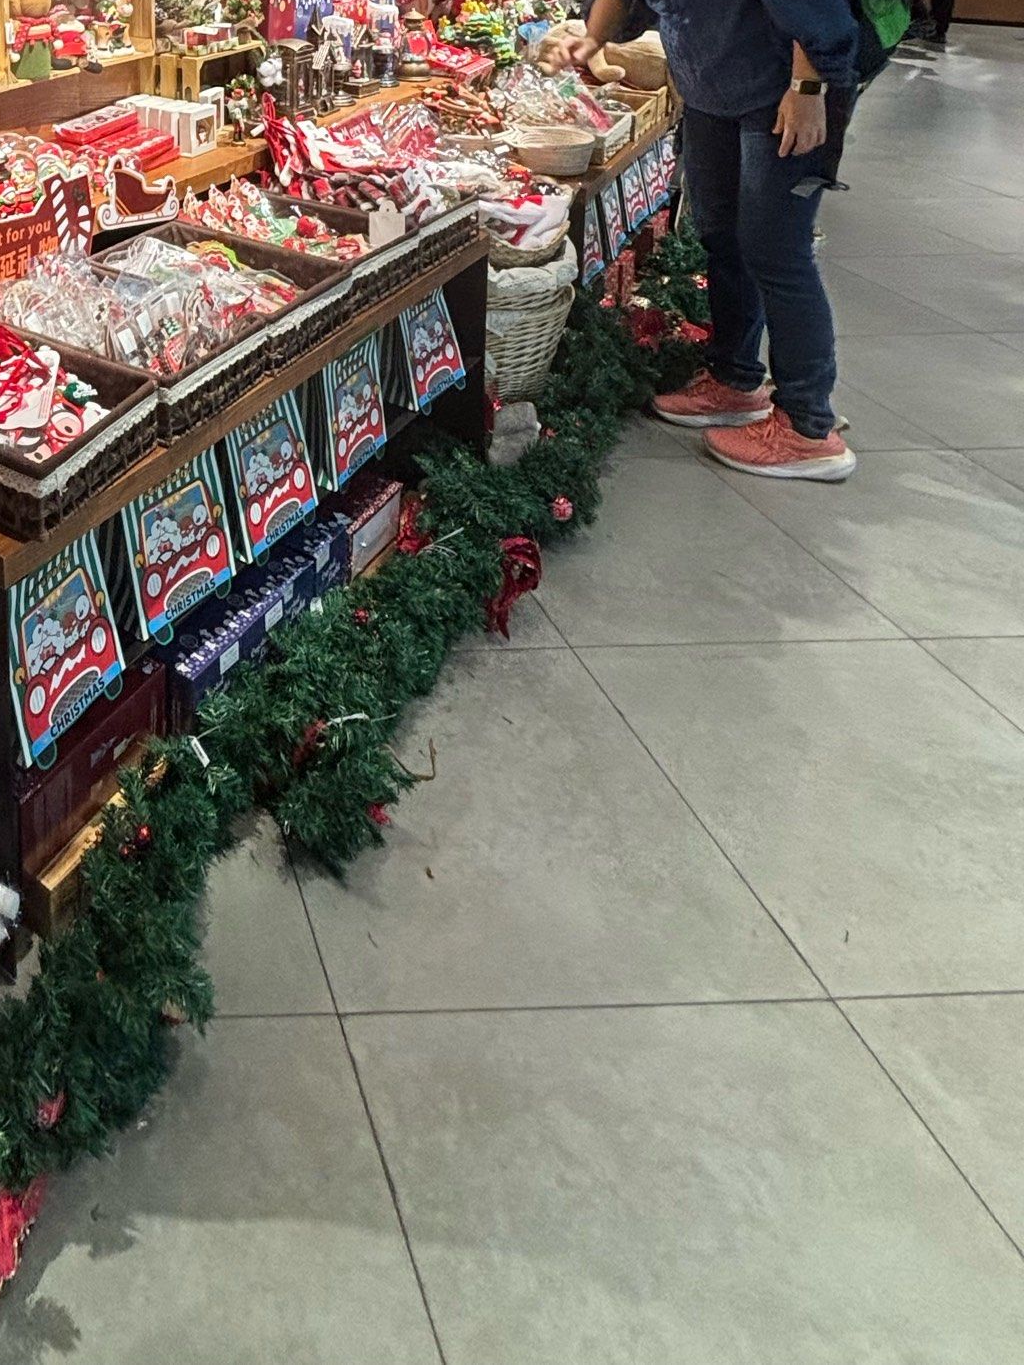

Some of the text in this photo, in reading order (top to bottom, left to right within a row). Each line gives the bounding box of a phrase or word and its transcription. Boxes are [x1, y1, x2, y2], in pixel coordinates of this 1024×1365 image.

[6, 227, 26, 244] for
[28, 220, 51, 240] you
[265, 507, 305, 546] CHRISTMAS
[165, 578, 216, 620] CHRISTMAS
[50, 677, 105, 738] CHRISTMAS
